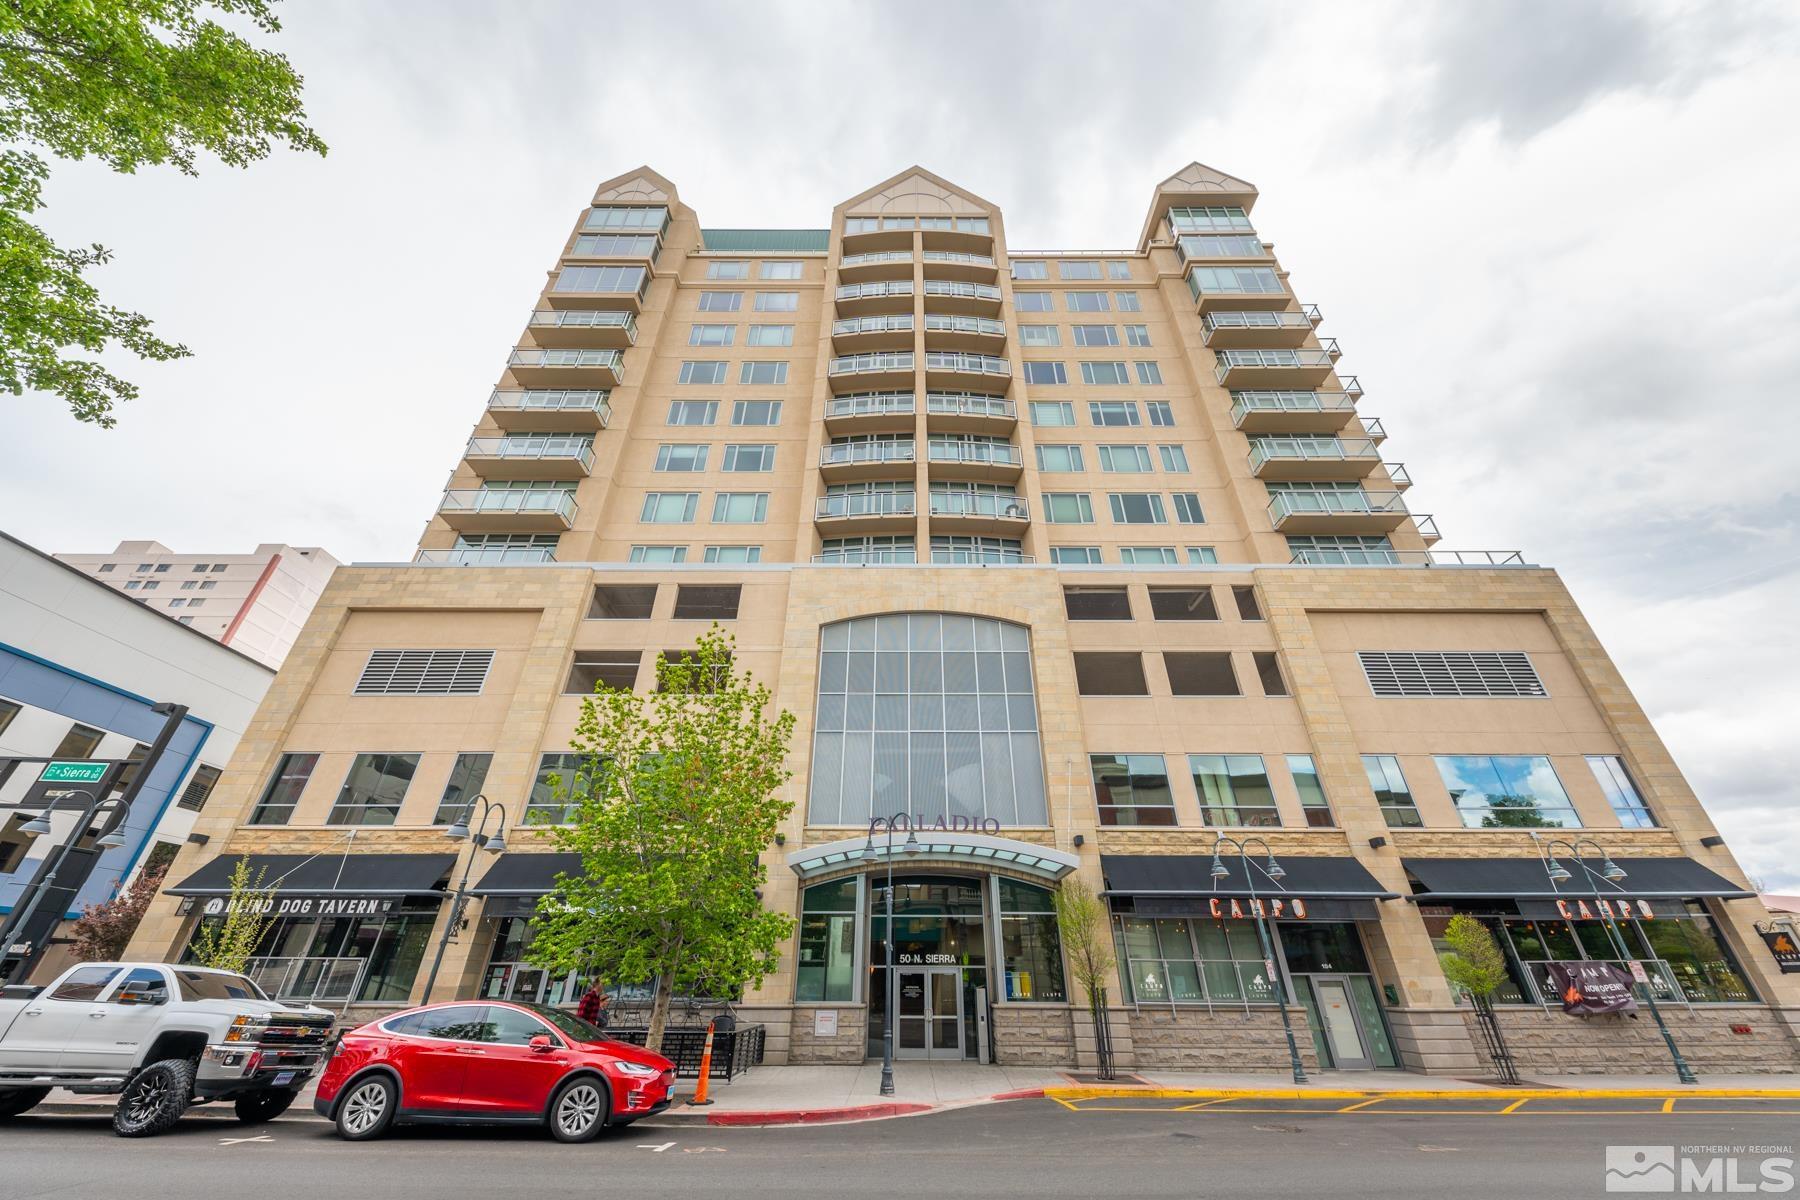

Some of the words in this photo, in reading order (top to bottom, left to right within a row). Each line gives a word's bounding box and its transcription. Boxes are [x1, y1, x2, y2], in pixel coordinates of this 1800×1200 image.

[60, 766, 92, 778] Sierra
[279, 899, 312, 914] DOG
[317, 899, 379, 914] TAVERN
[1209, 898, 1306, 919] CAMPO
[1556, 899, 1654, 920] CAMPO
[899, 954, 911, 964] 50
[925, 953, 957, 964] SIERRA
[1584, 984, 1600, 993] NOW
